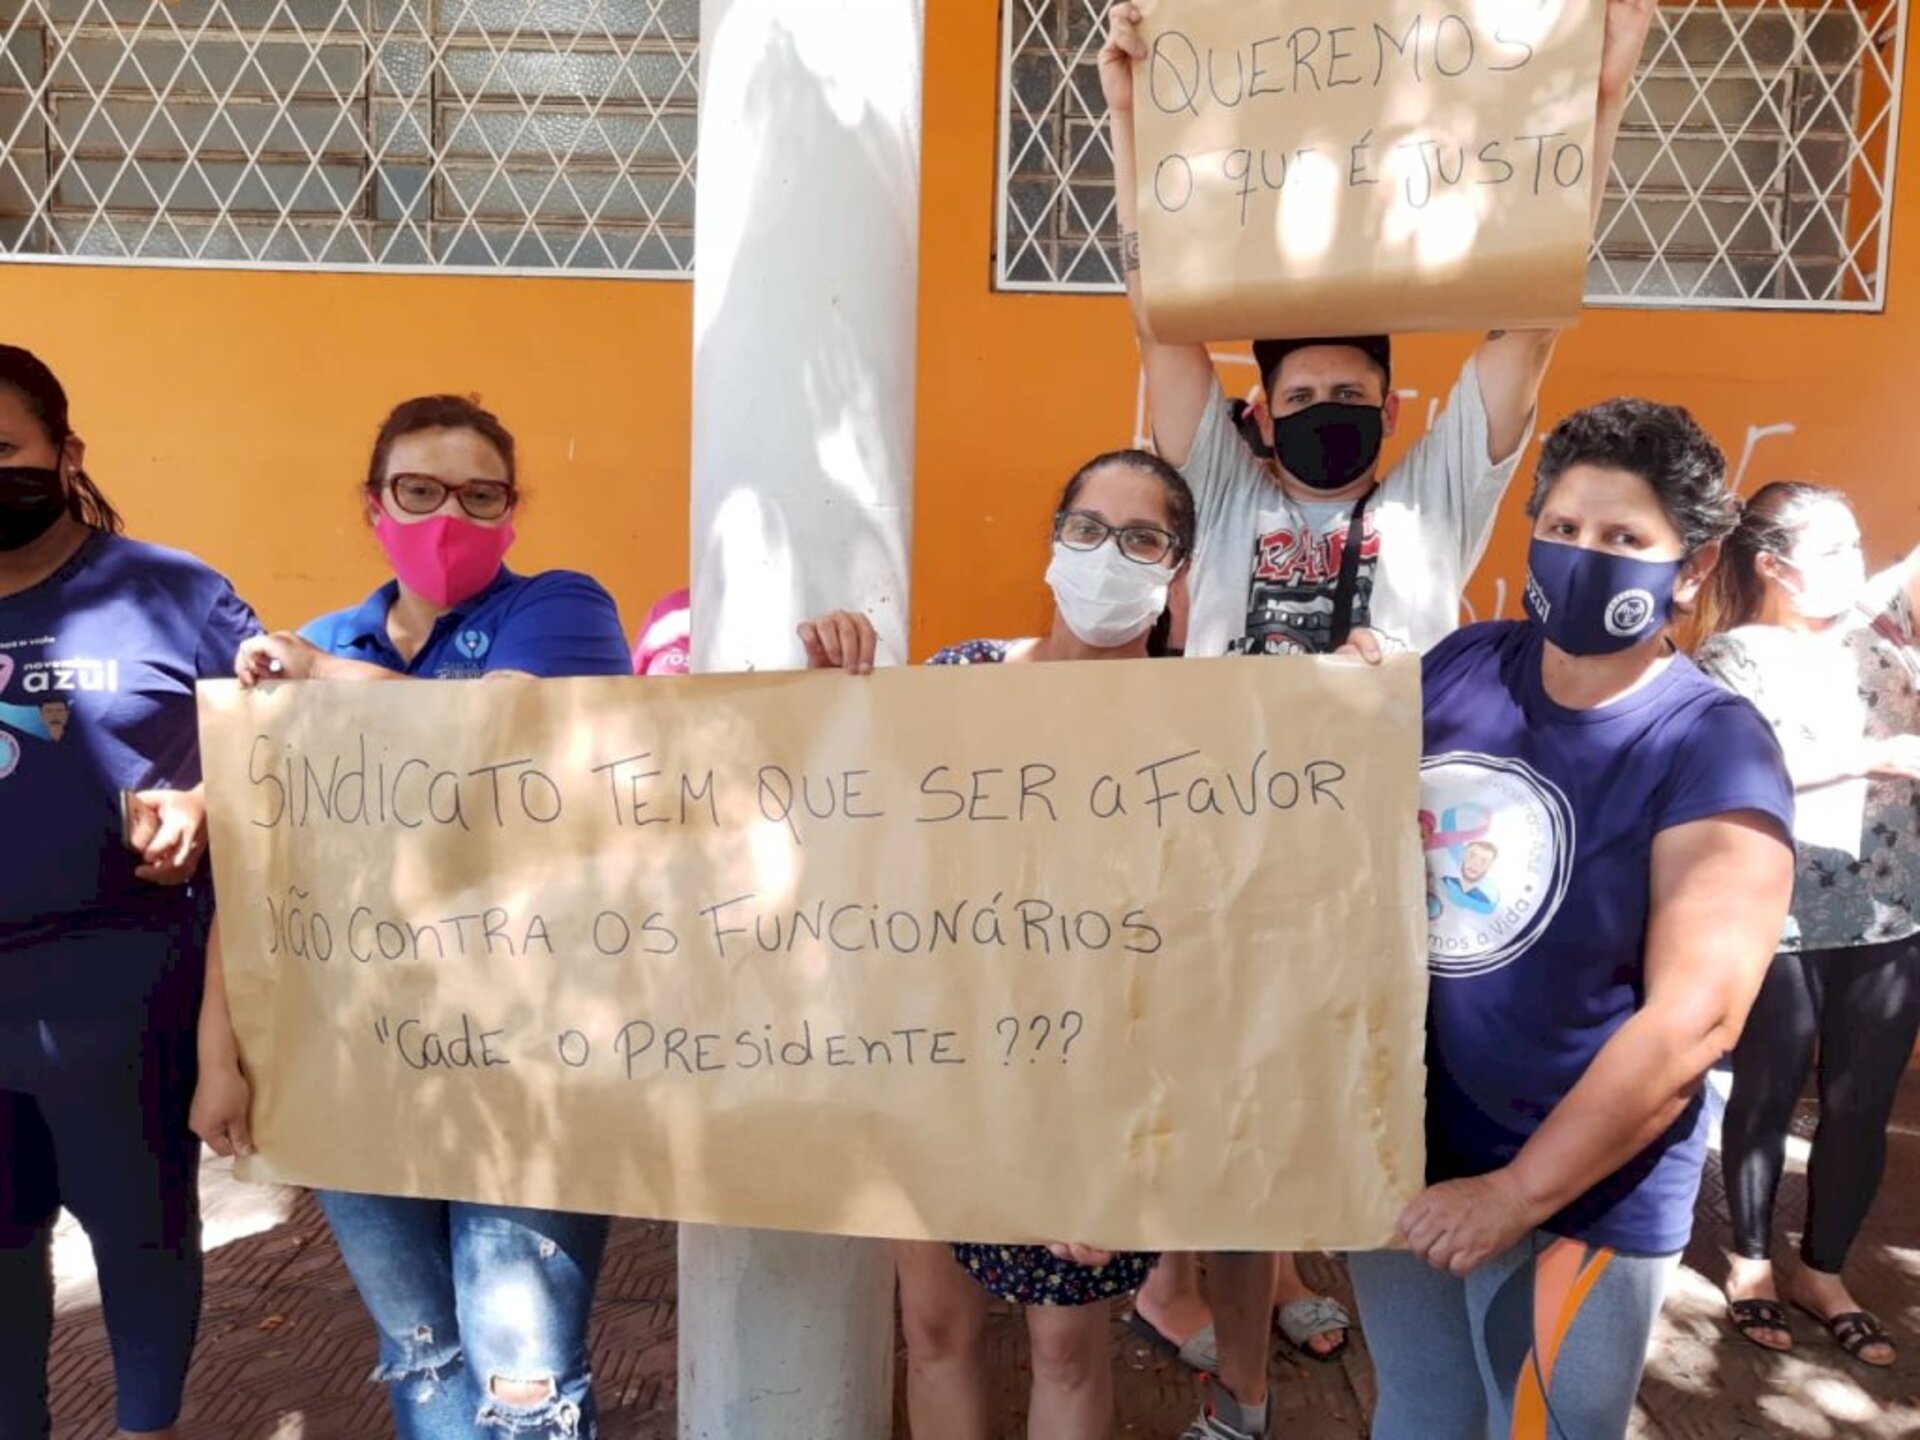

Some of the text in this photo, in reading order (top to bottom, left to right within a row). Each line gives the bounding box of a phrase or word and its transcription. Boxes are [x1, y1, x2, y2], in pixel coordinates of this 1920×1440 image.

[1153, 152, 1194, 213] O
[1348, 128, 1380, 188] É
[1403, 131, 1585, 209] JUSTO
[22, 658, 118, 693] azul
[591, 751, 720, 828] TEM
[757, 765, 885, 846] QUE
[914, 763, 1058, 824] SER
[592, 908, 679, 957] OS
[995, 1009, 1084, 1069] ???
